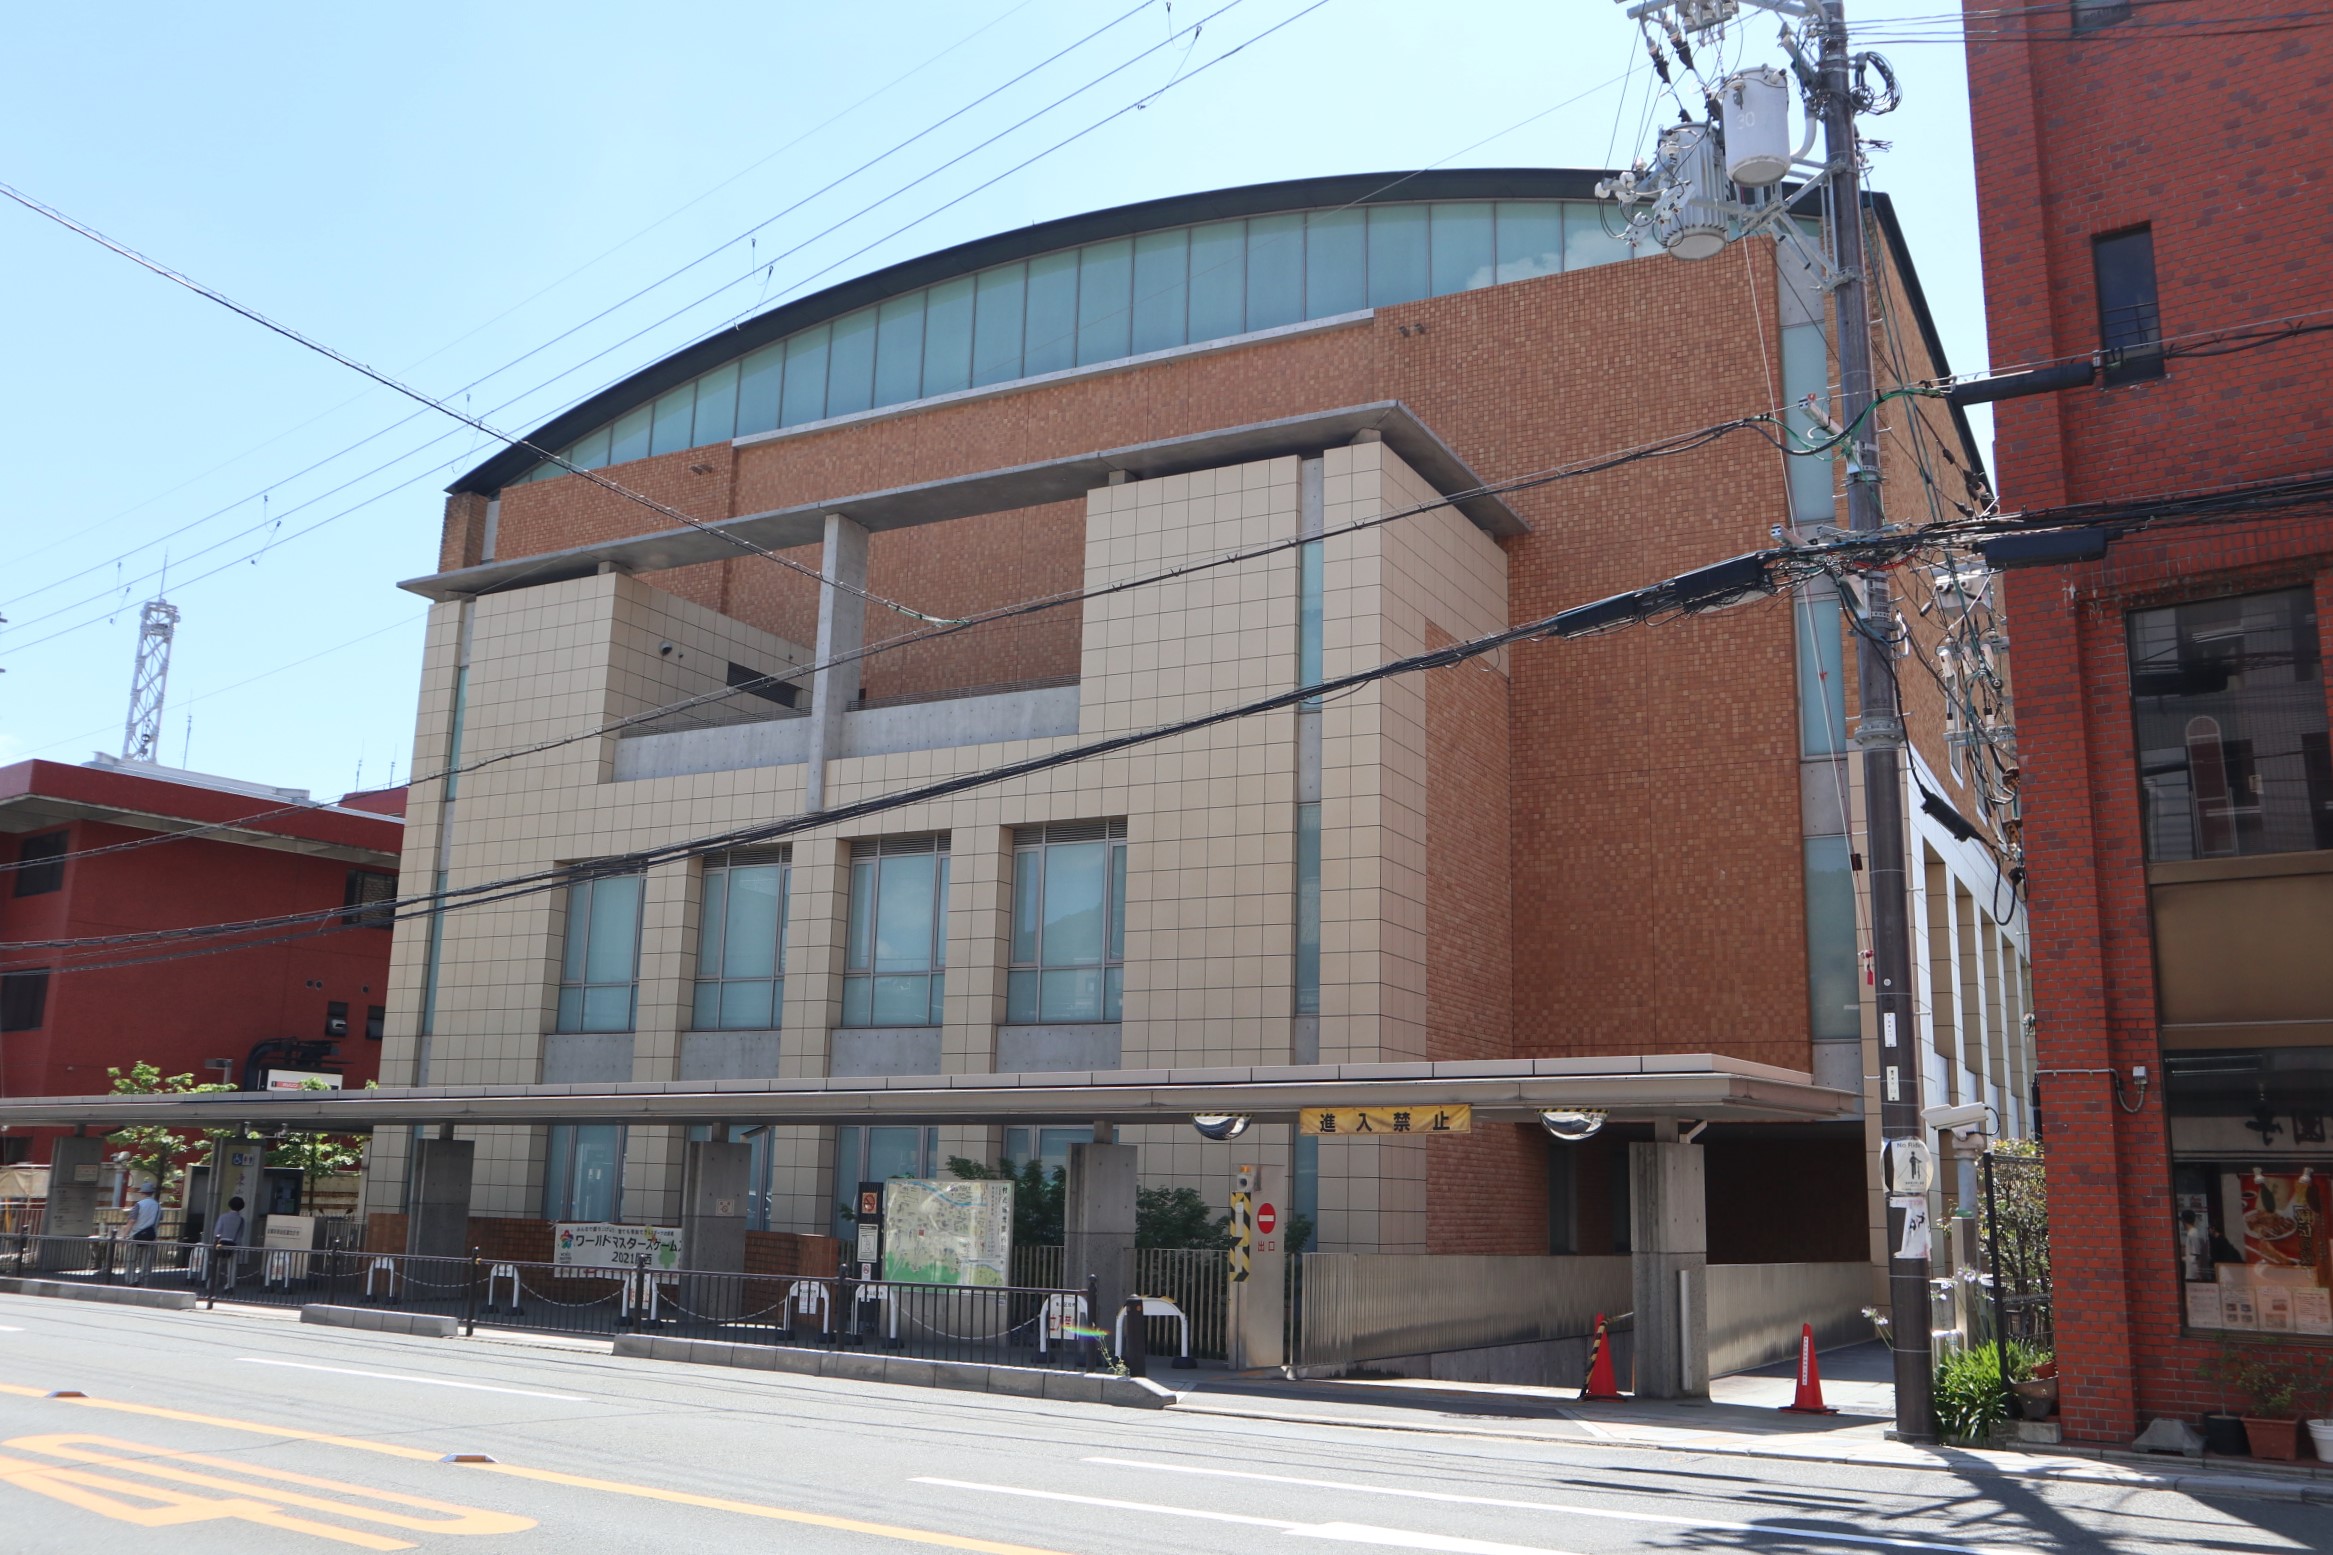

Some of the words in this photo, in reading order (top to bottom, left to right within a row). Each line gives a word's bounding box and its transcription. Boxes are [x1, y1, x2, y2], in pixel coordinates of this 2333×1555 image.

[1736, 110, 1756, 130] 30
[1319, 1110, 1450, 1133] 進入禁止
[1258, 1240, 1275, 1252] 出口
